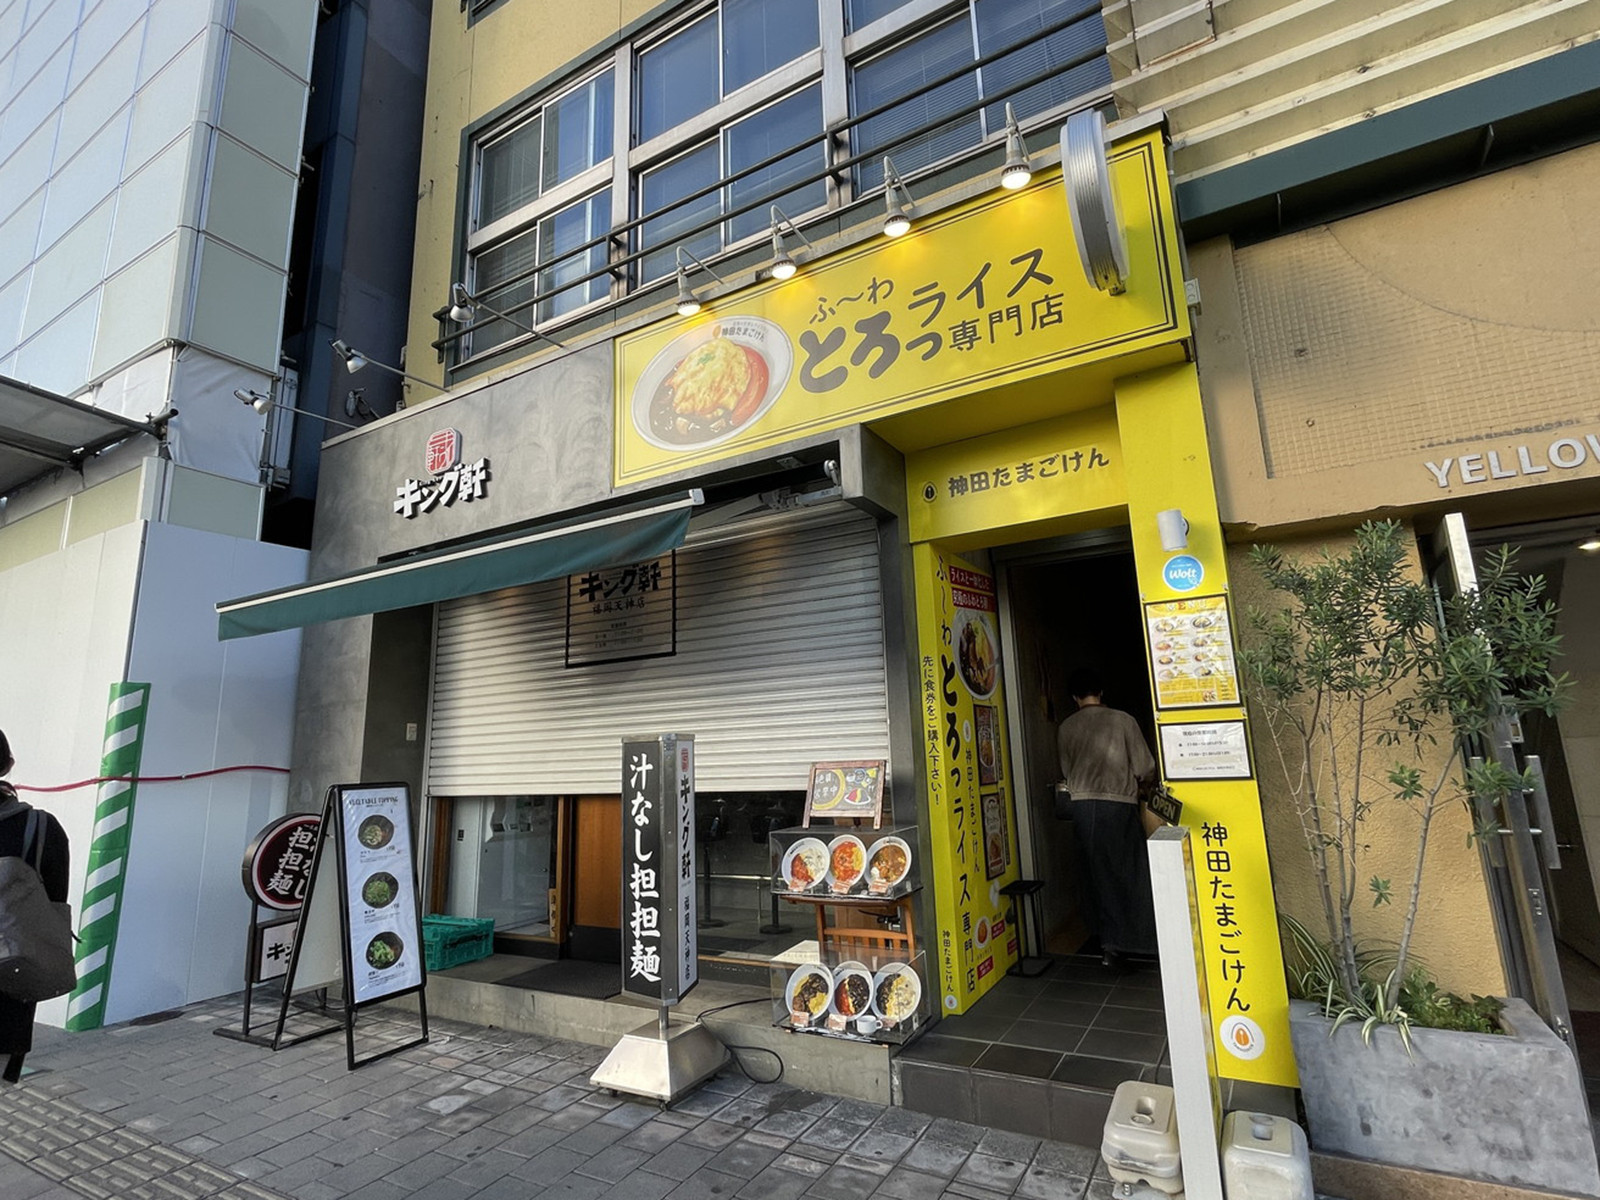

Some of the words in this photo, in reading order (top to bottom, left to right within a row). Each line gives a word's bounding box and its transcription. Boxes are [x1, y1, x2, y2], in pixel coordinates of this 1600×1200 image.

[908, 248, 1053, 329] ライス
[948, 293, 1065, 352] 専門店
[393, 457, 491, 519] キング軒
[948, 448, 1110, 498] 神田たまごけん
[579, 561, 661, 602] キング軒
[1152, 794, 1176, 820] OPEN
[629, 753, 661, 982] 汁なし担担麺
[1201, 822, 1251, 1012] 神田たまごけん
